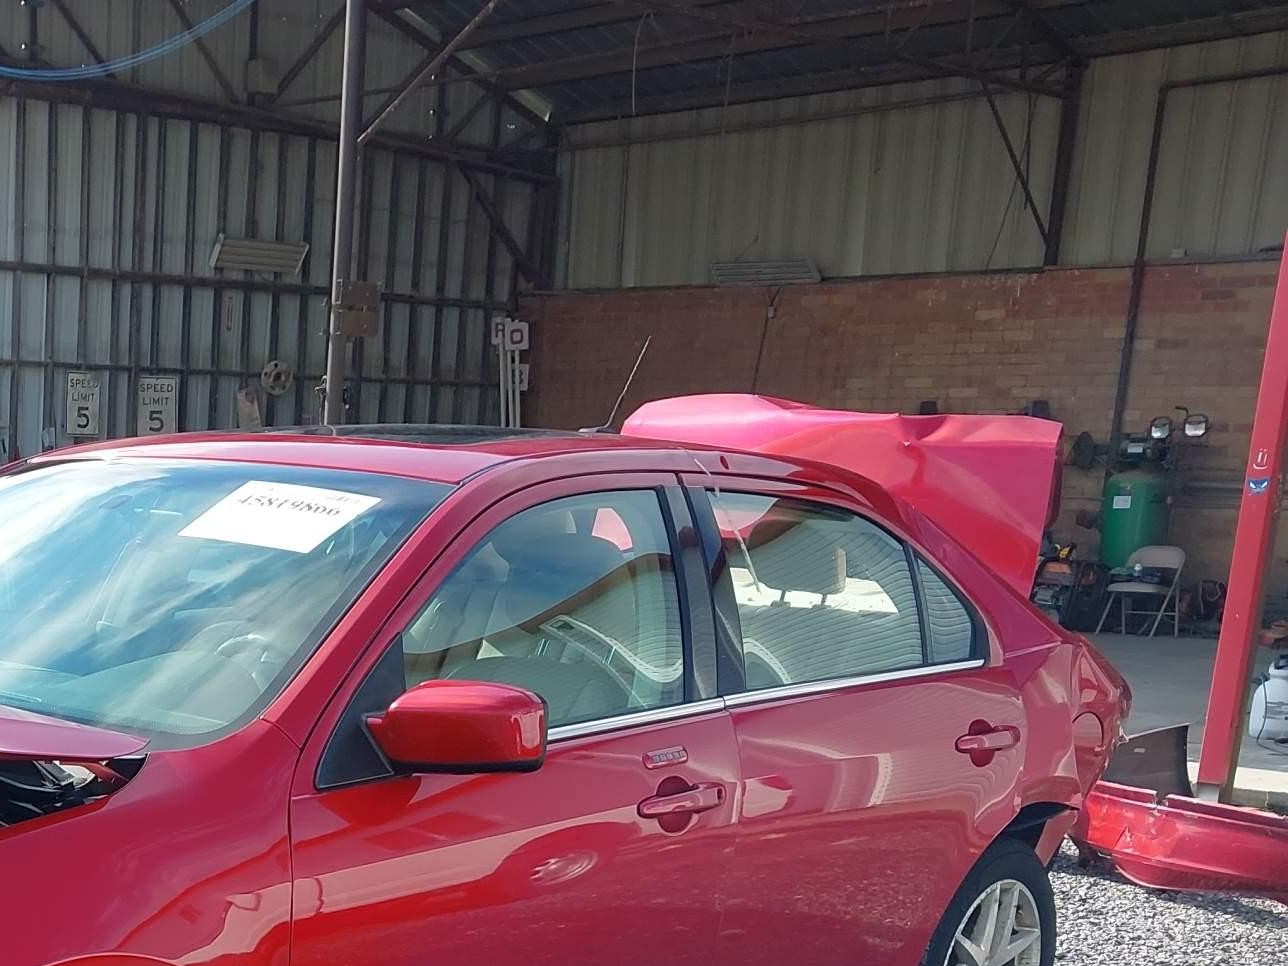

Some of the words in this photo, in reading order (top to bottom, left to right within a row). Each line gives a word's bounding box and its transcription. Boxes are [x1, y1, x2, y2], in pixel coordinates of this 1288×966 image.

[69, 378, 99, 388] SPEED
[140, 384, 174, 393] SPEED
[72, 392, 95, 402] LIMIT
[142, 397, 170, 406] LIMIT
[77, 406, 90, 429] 5
[149, 410, 164, 432] 5
